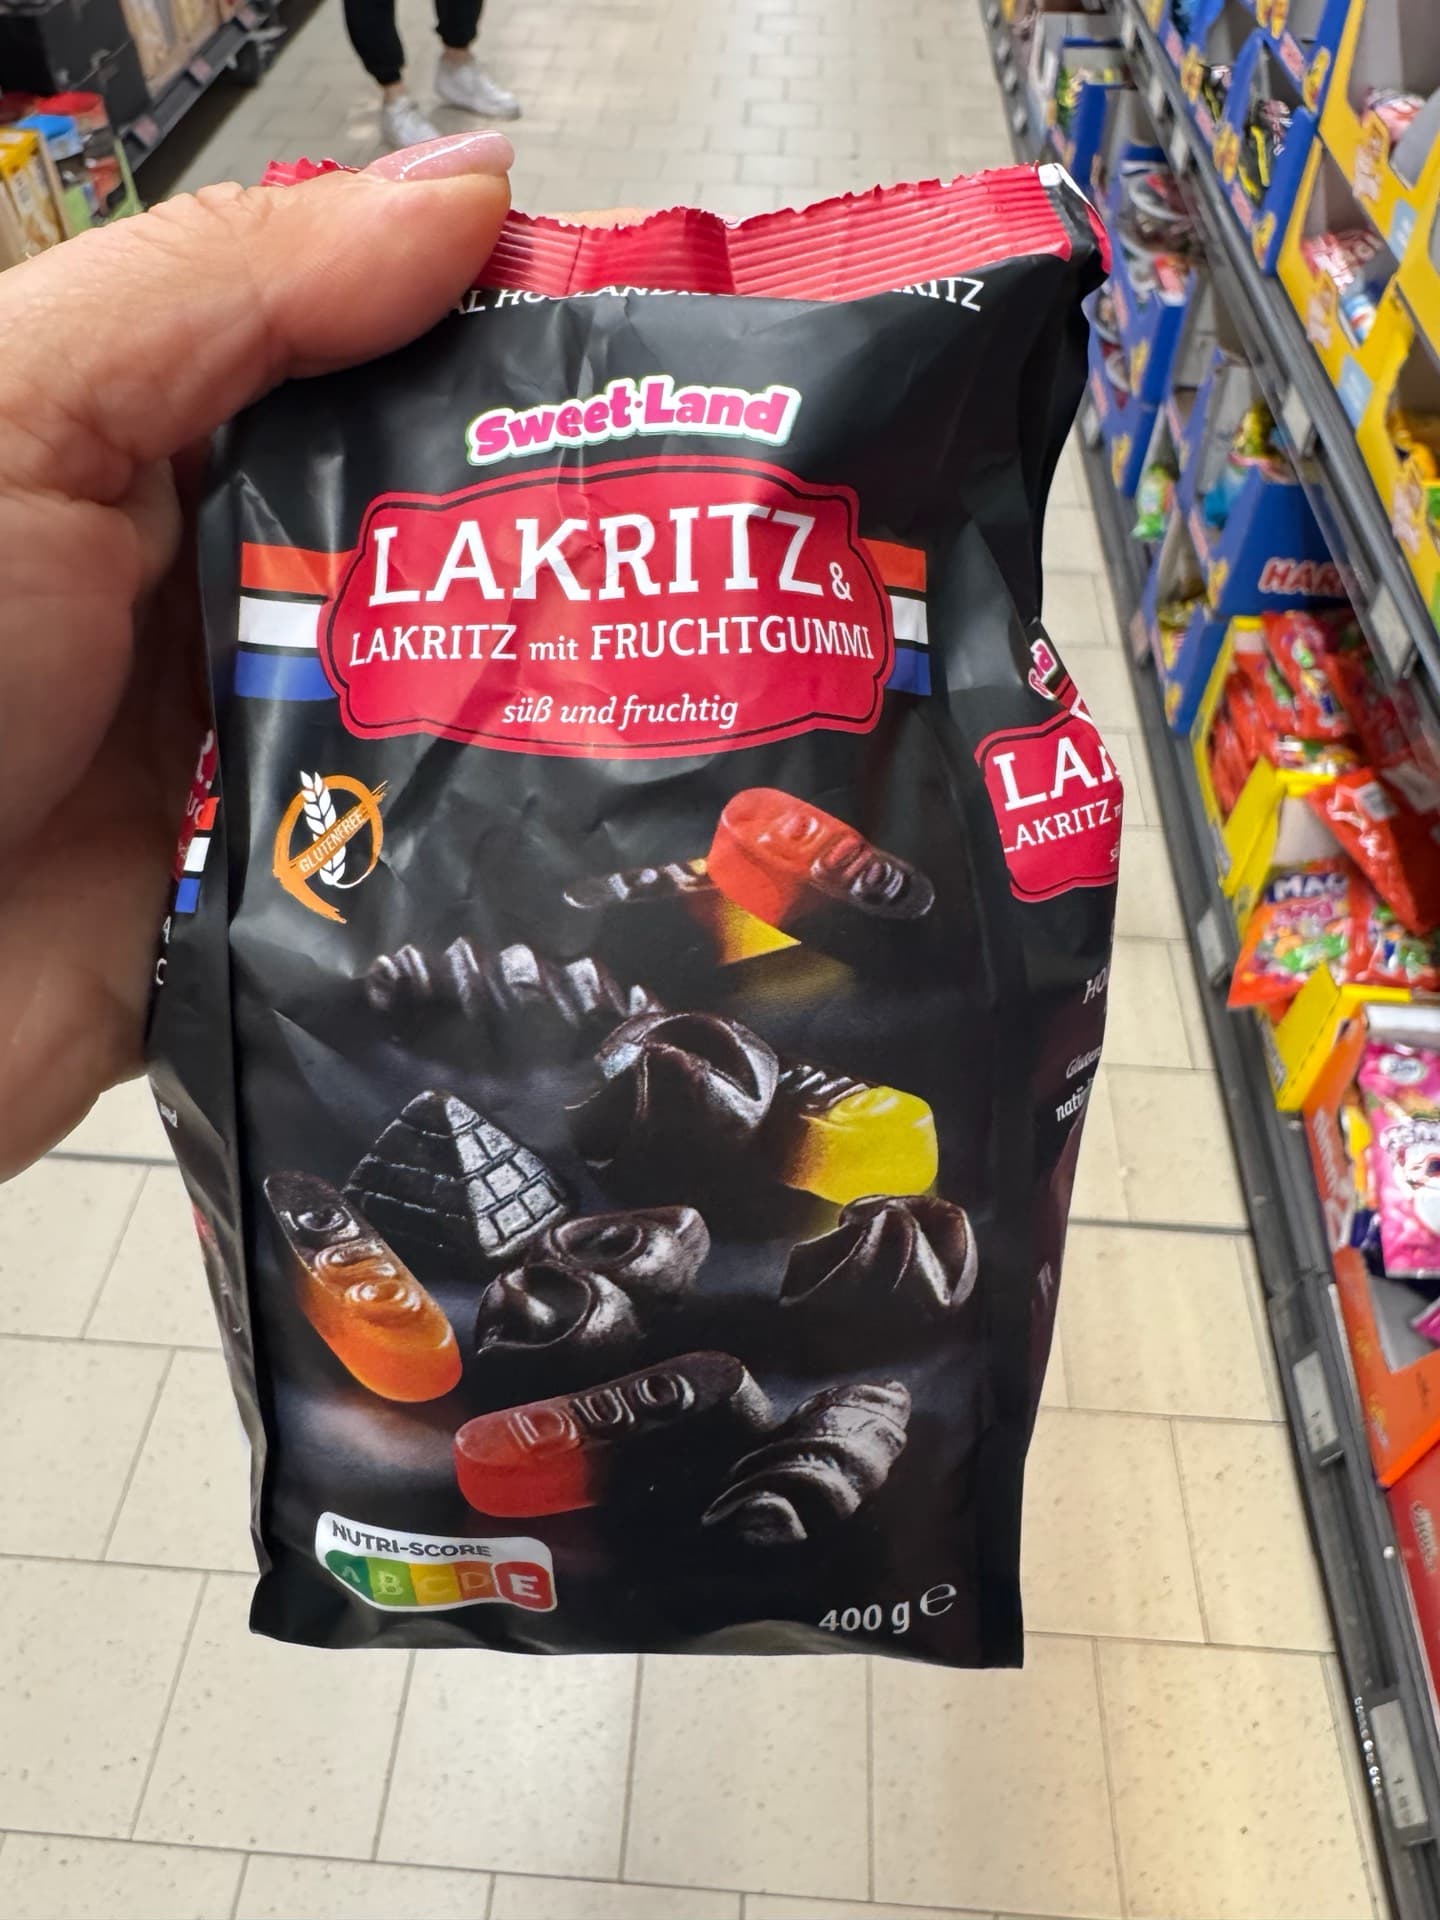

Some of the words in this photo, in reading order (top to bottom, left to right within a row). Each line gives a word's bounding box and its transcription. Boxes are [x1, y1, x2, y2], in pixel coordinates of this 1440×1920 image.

[369, 503, 824, 608] LAKRITZ
[831, 562, 854, 602] &
[349, 624, 518, 667] LAKRITZ
[528, 637, 579, 662] mit
[590, 616, 876, 662] FRUCHTGUMMI
[501, 698, 552, 725] süß
[560, 698, 619, 727] und
[620, 698, 740, 731] fruchtig
[331, 1519, 492, 1558] NUTRI-SCORE
[509, 1572, 541, 1600] E
[818, 1603, 883, 1632] 400
[891, 1601, 911, 1635] g
